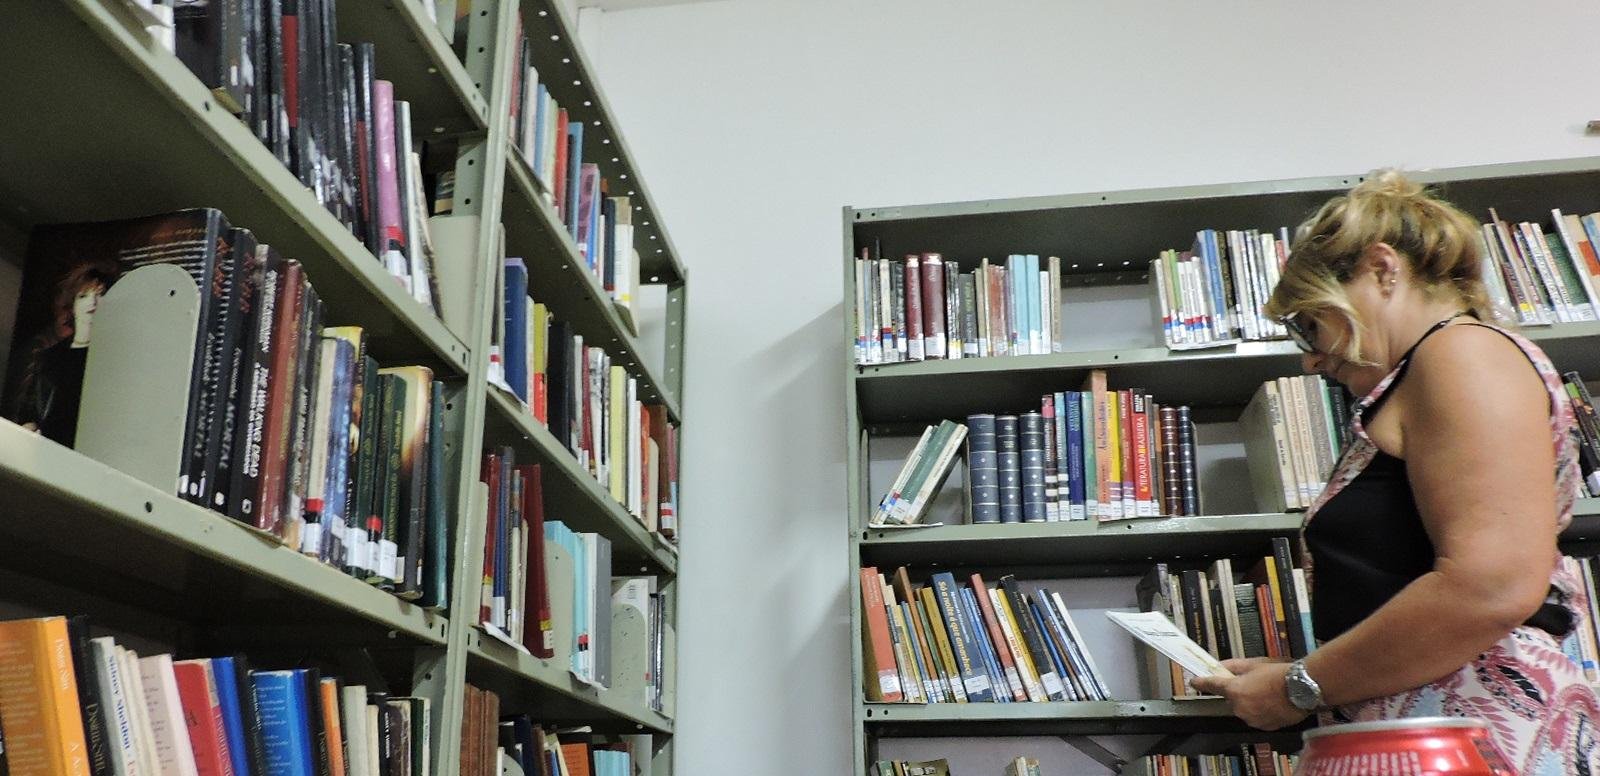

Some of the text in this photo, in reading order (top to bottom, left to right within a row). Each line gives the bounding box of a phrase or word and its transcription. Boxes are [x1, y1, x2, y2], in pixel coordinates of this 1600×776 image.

[259, 366, 271, 389] THE
[219, 401, 235, 469] MORTAL
[253, 389, 267, 442] WALKING
[249, 443, 261, 478] DEAD
[938, 581, 947, 591] Só
[943, 597, 954, 617] noite
[950, 622, 960, 637] que
[108, 655, 130, 750] Sidney Sheldon
